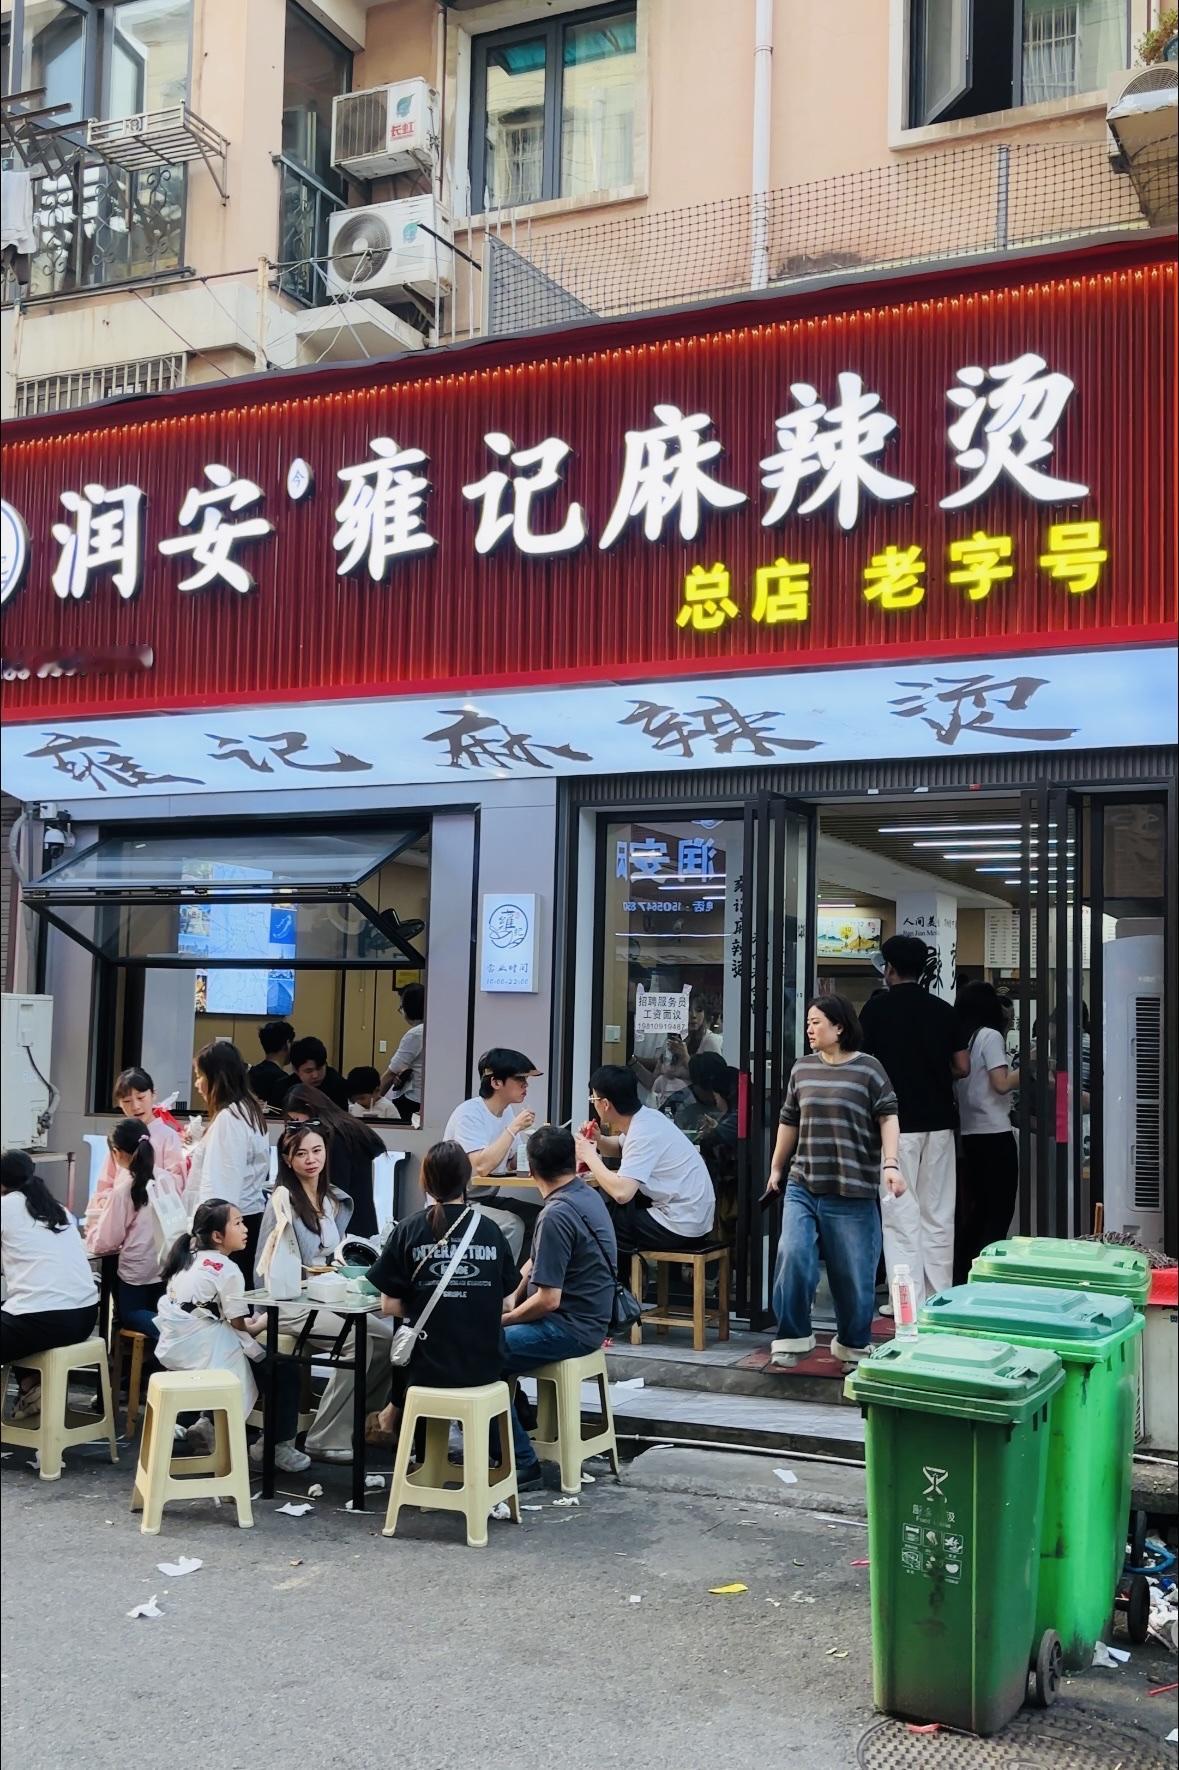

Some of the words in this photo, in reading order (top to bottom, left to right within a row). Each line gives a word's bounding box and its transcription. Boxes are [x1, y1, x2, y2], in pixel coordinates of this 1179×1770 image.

[676, 557, 811, 630] 总店
[863, 521, 1108, 609] 老字号
[638, 995, 687, 1008] 招聘服务员
[643, 1009, 682, 1020] 工资面议
